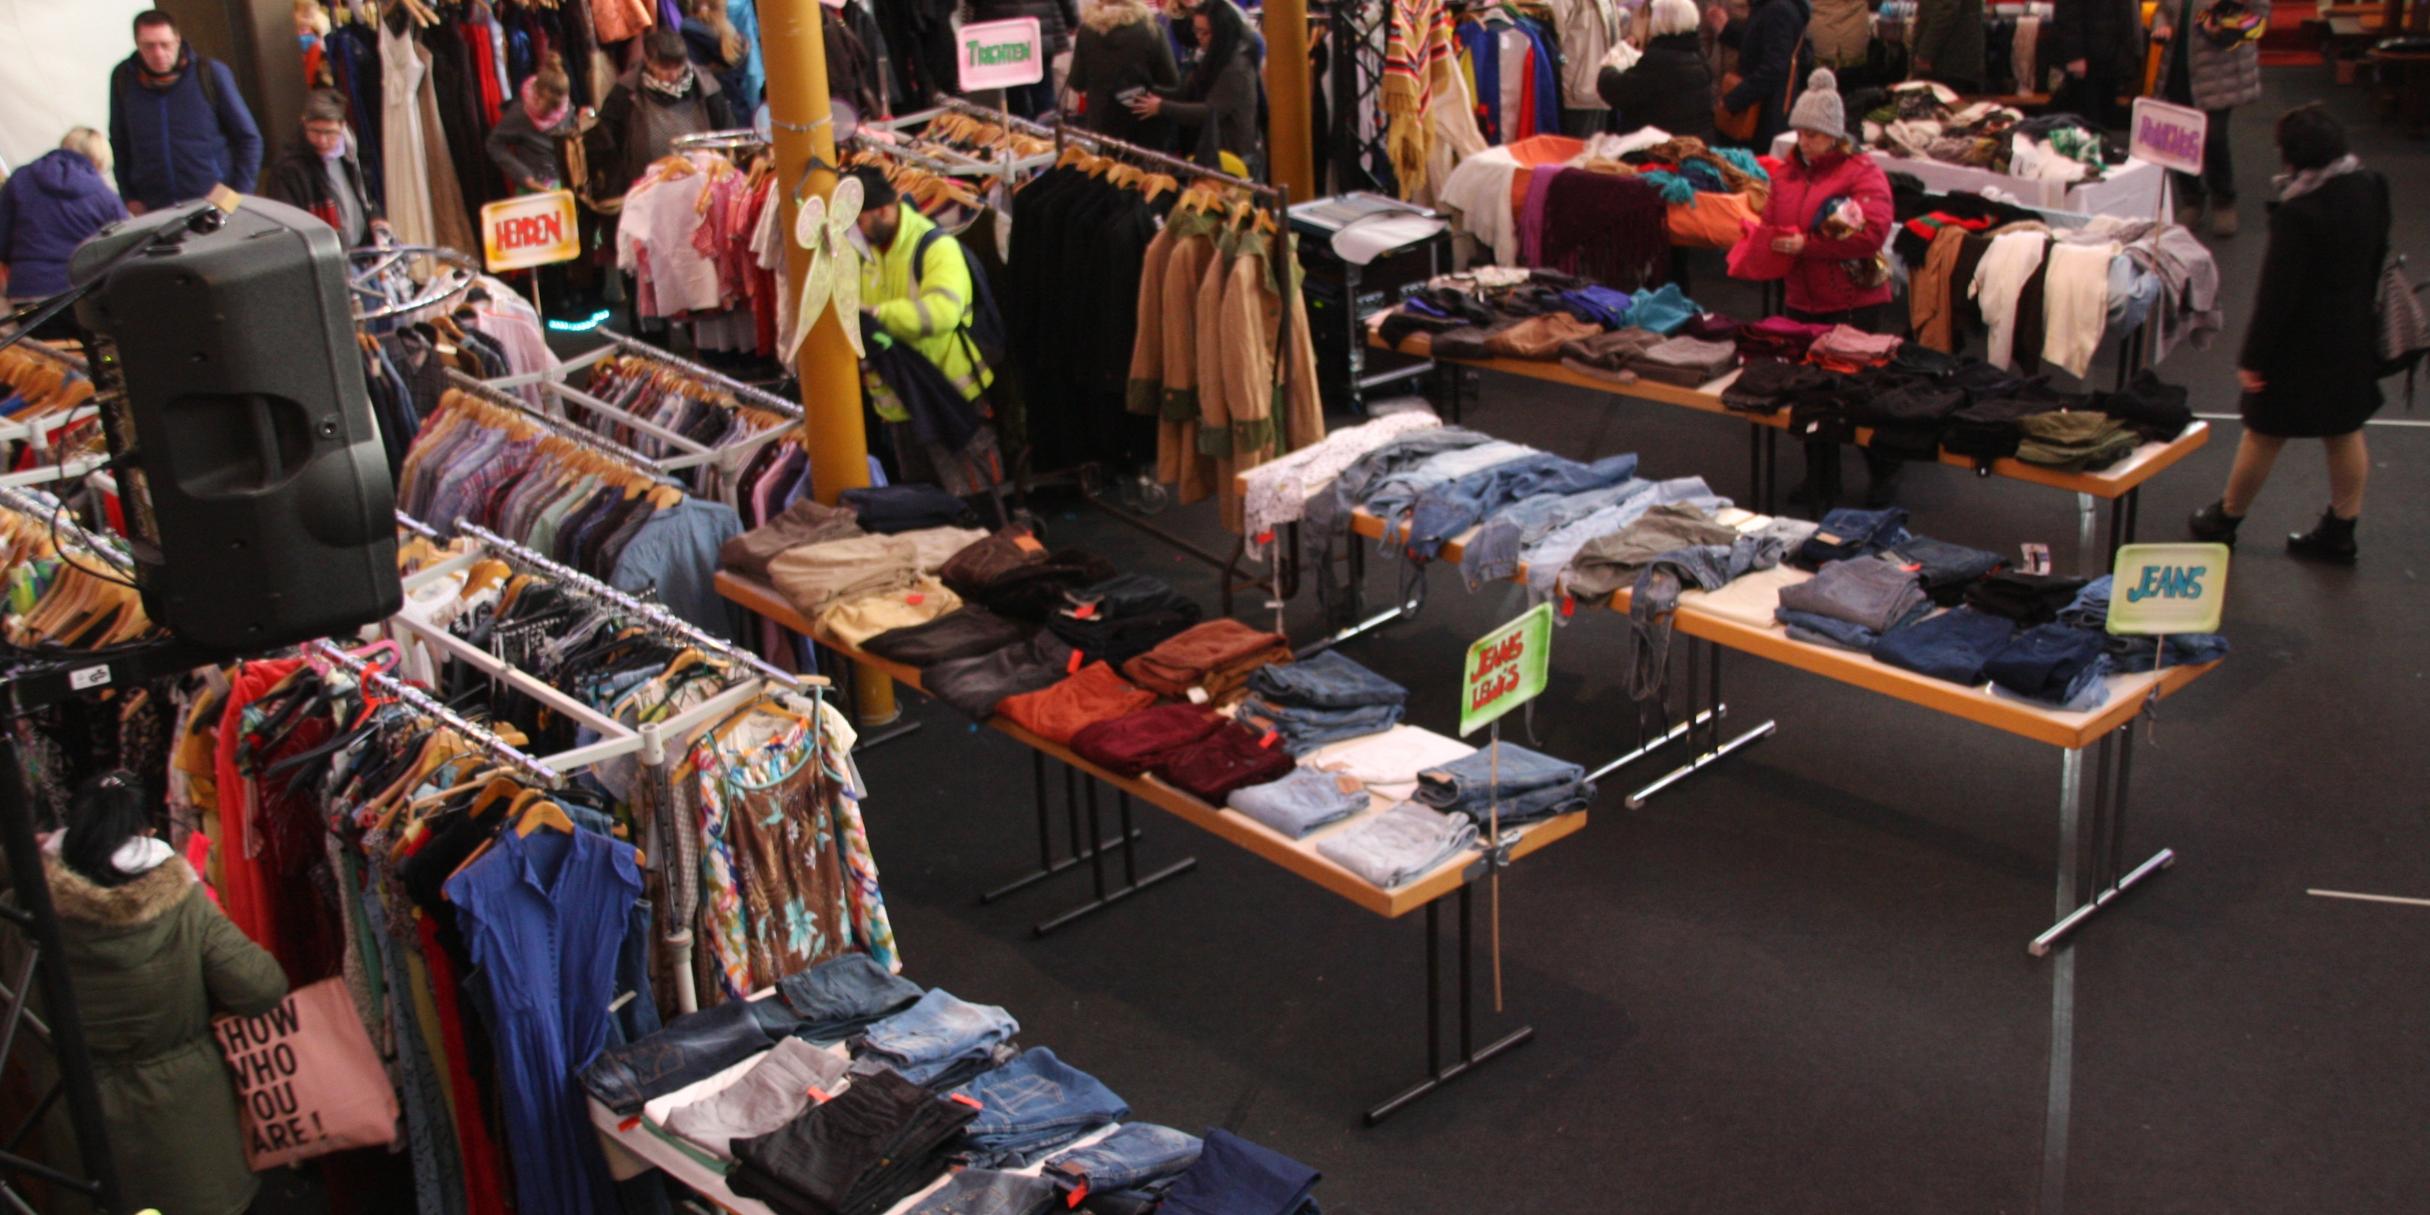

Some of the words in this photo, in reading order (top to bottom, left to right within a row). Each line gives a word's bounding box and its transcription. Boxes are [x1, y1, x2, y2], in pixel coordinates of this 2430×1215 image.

[2127, 565, 2207, 603] JEANS
[1470, 630, 1524, 684] JEANS
[214, 998, 300, 1054] HOW
[244, 1080, 298, 1121] OU
